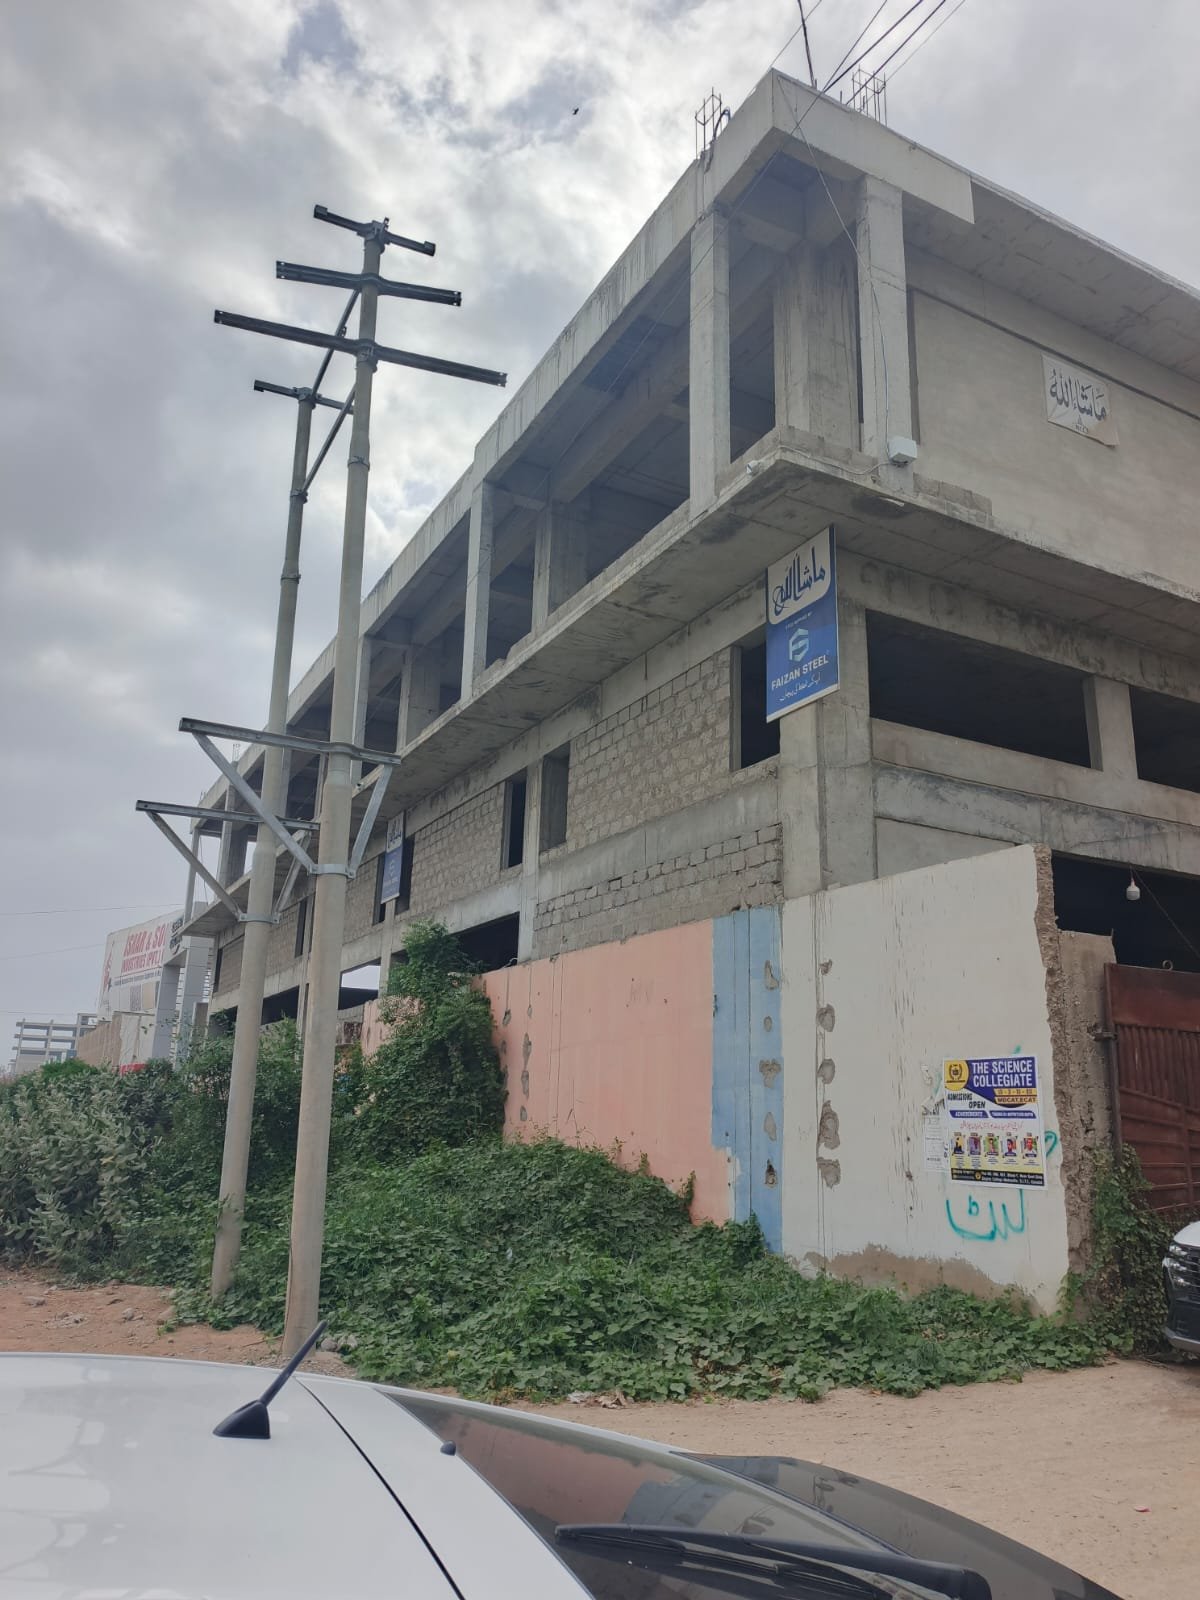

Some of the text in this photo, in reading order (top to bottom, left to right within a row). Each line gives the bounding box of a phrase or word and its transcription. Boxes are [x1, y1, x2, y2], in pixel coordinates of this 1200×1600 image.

[771, 667, 801, 691] FAIZAN
[802, 654, 829, 675] STEEL
[971, 1060, 1033, 1074] THE SCIENCE
[973, 1074, 1033, 1088] COLLEGIATE
[968, 1100, 986, 1109] OPEN
